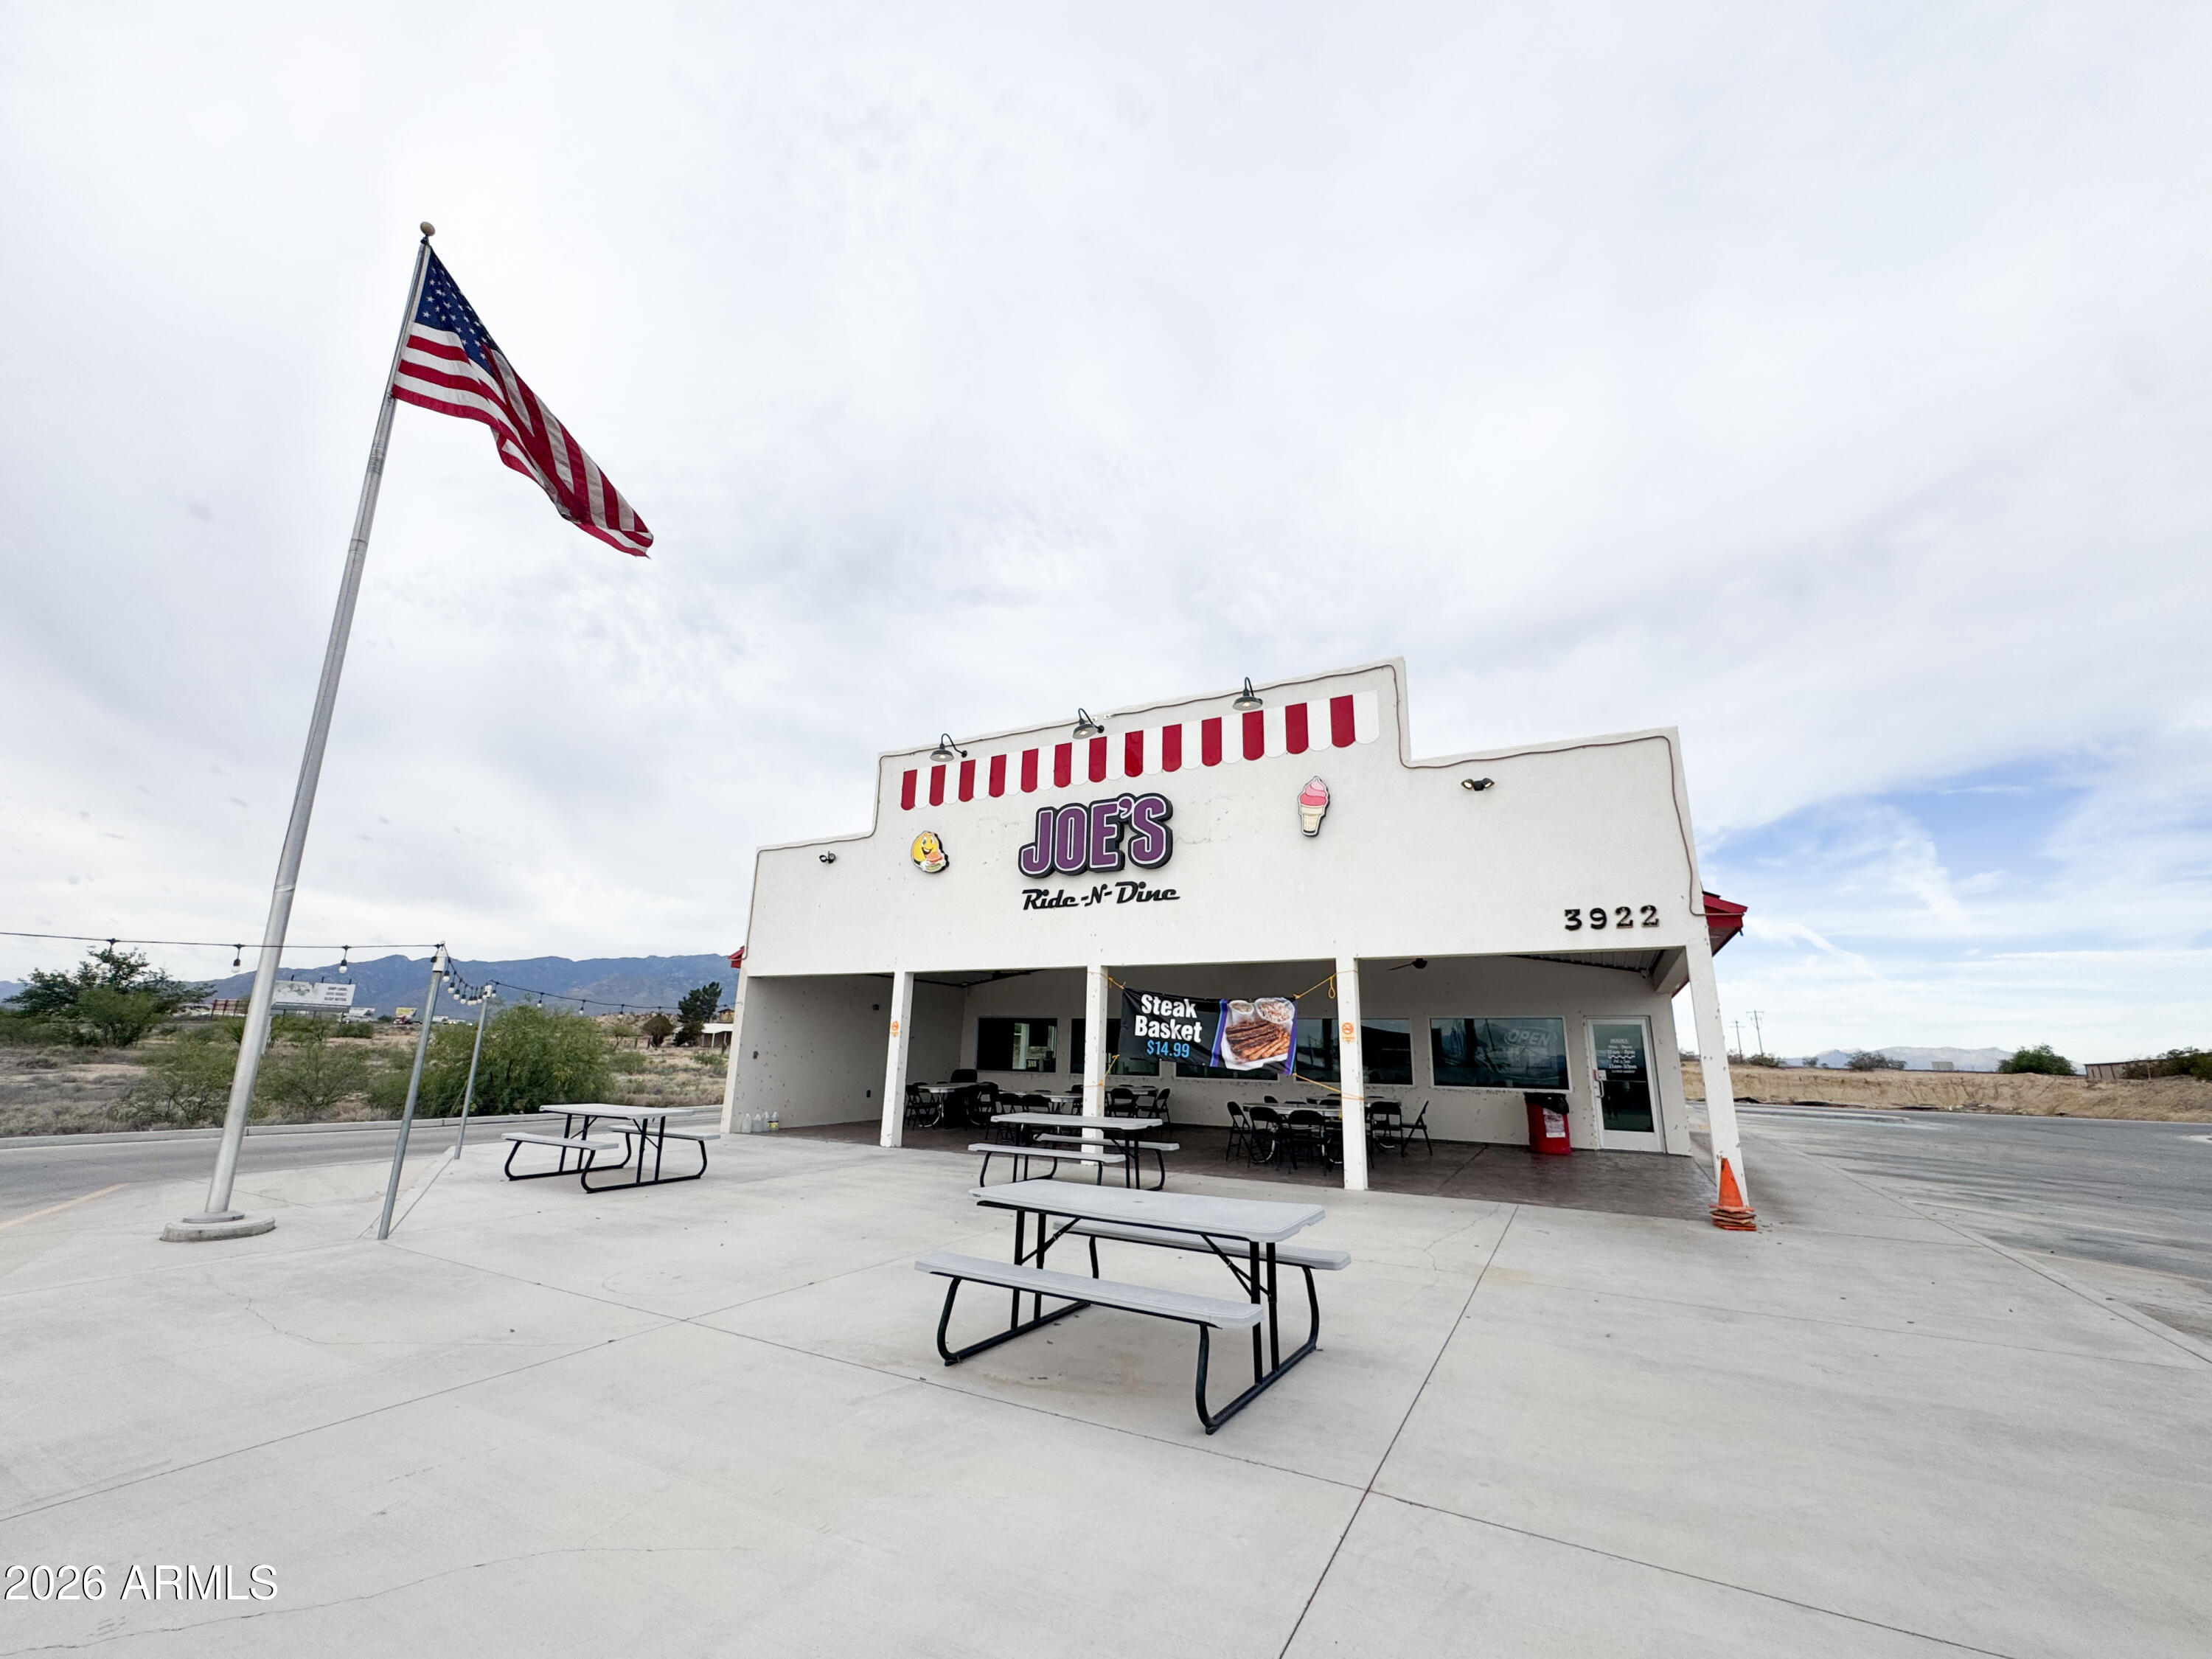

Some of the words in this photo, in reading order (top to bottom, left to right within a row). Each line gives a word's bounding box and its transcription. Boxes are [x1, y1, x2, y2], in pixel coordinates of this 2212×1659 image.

[1018, 793, 1173, 878] JOE'S
[1564, 905, 1660, 931] 3922
[1141, 994, 1197, 1018] Steak
[1135, 1015, 1203, 1043] Basket
[1507, 1029, 1550, 1046] OPEN
[1147, 1039, 1190, 1058] $14.99
